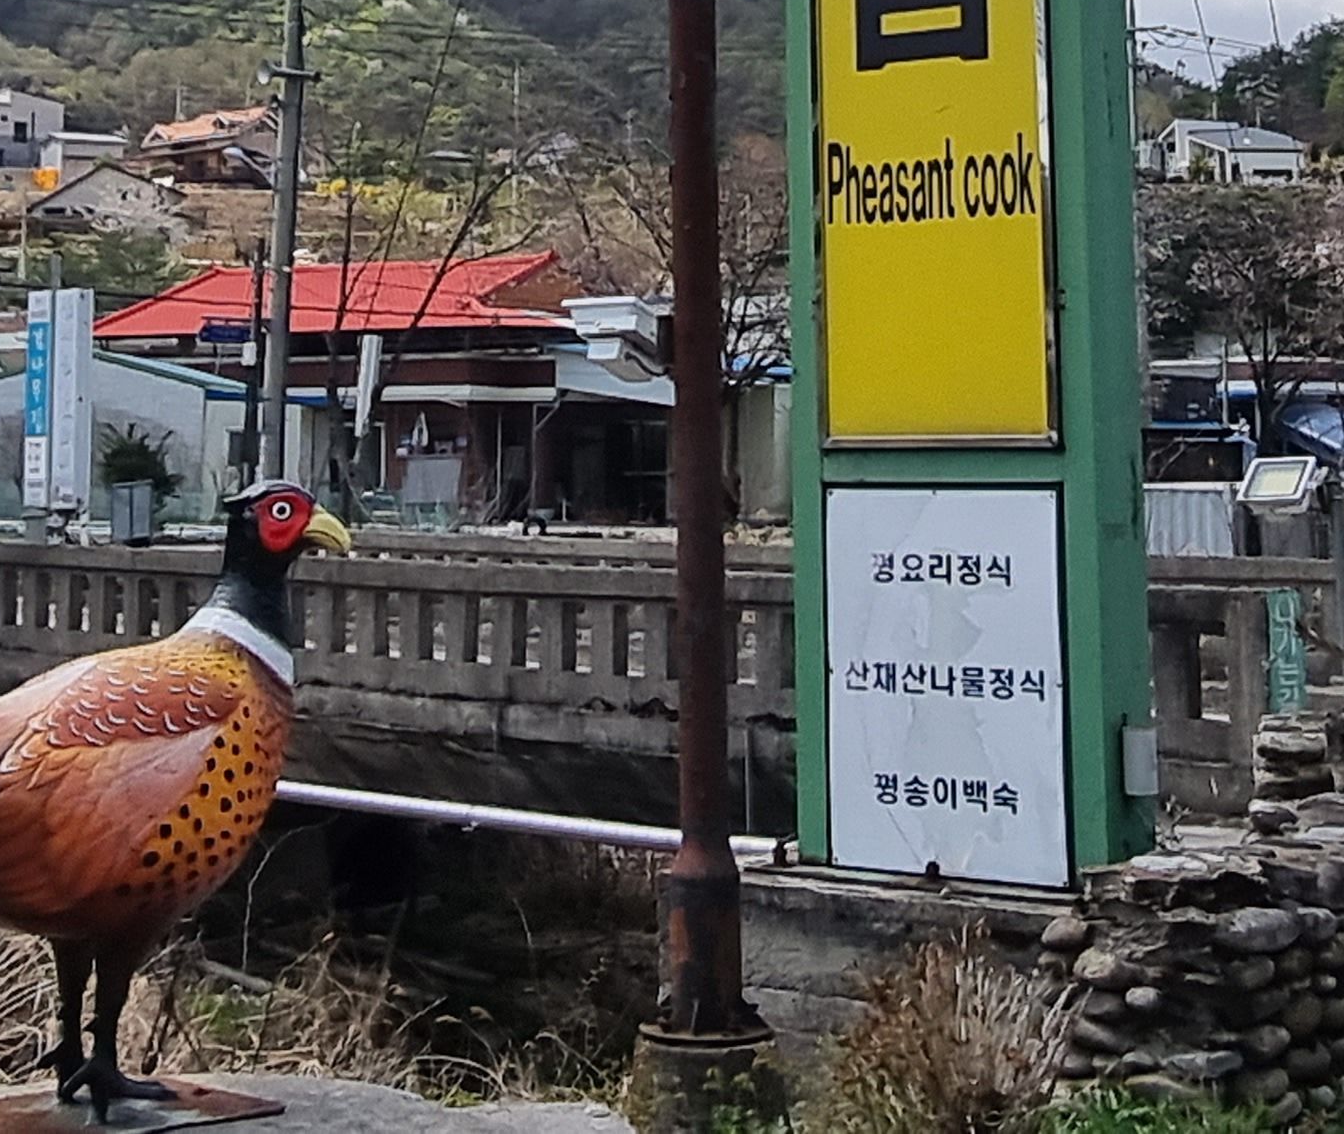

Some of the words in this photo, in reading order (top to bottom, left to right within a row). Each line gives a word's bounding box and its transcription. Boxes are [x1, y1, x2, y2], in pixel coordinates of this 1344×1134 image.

[827, 137, 955, 225] Pheasant
[963, 131, 1036, 218] cook
[870, 552, 1013, 587] 꿩요리정식
[873, 772, 1020, 816] 꿩송이백숙
